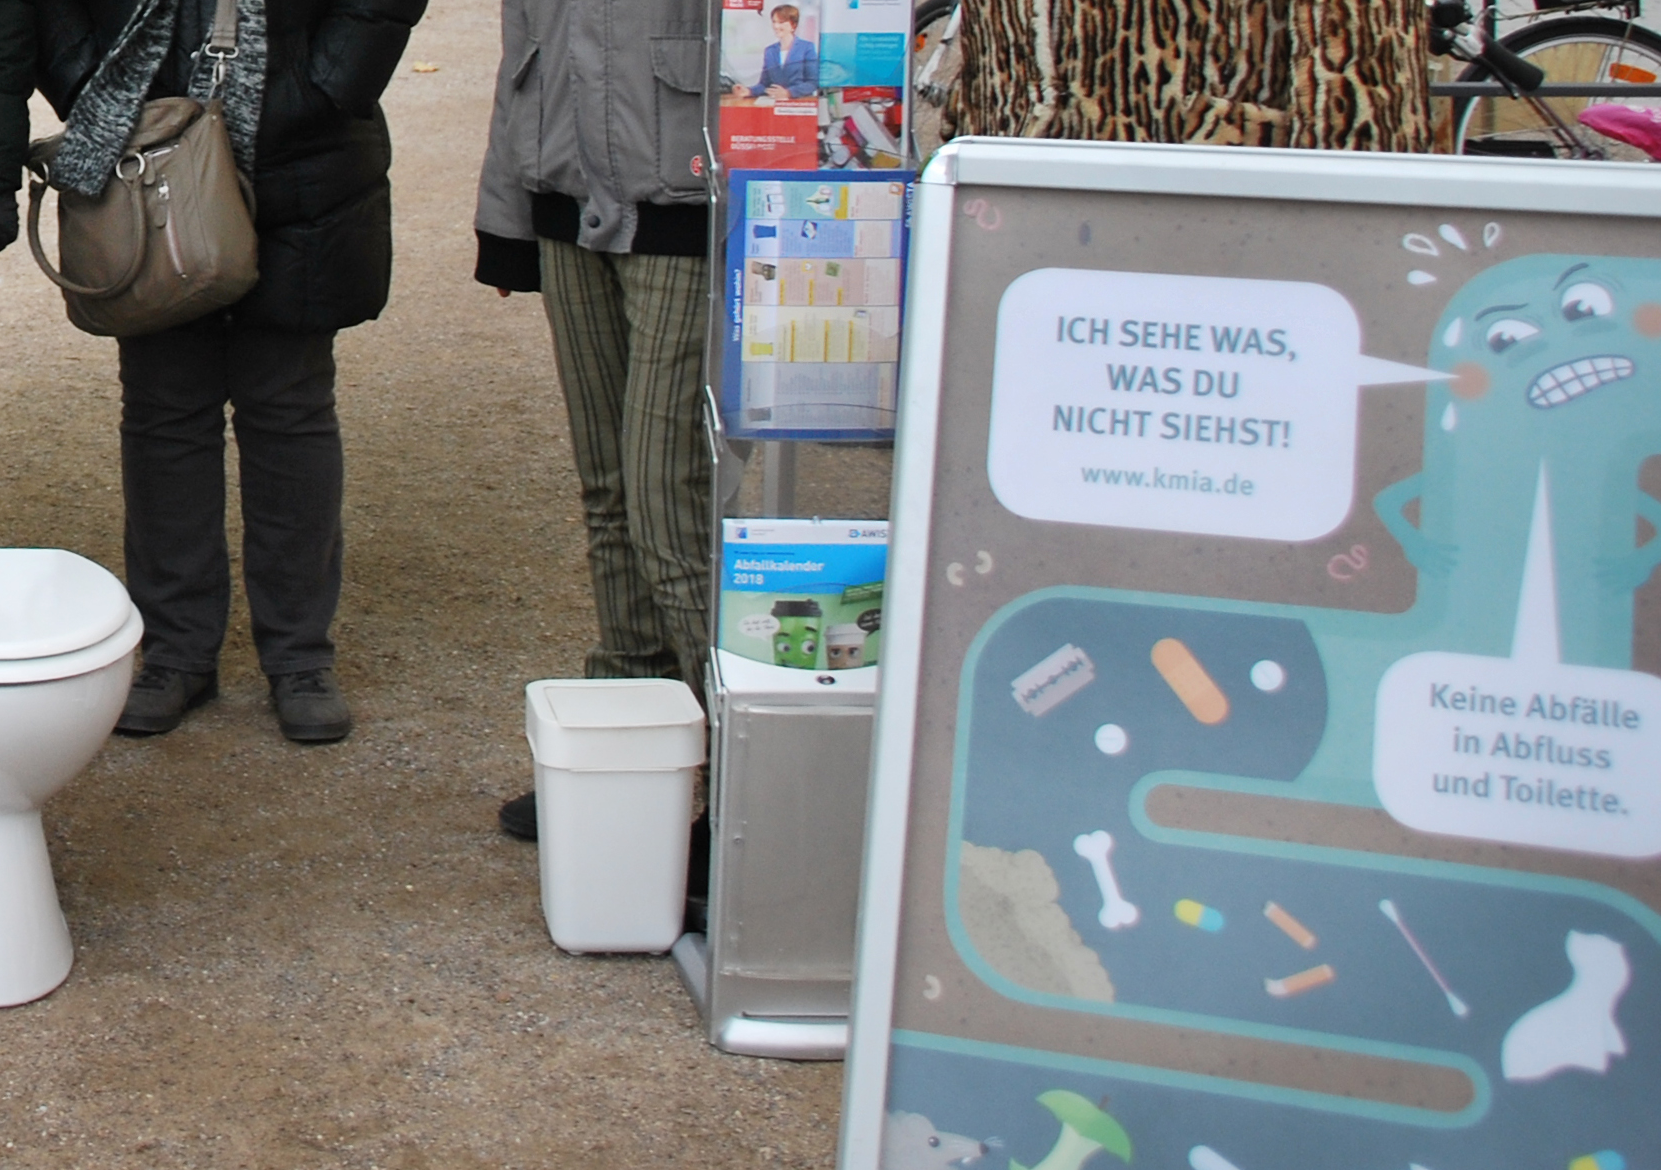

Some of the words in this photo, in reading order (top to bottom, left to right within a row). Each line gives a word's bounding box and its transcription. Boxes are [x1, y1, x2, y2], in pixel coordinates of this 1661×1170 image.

[1056, 316, 1110, 347] ICH
[1119, 318, 1202, 351] SEHE
[1210, 325, 1298, 363] WAS,
[1106, 363, 1183, 395] WAS
[1192, 368, 1240, 399] DU
[1052, 404, 1152, 440] NICHT
[1159, 412, 1292, 450] SIEHST!
[1080, 462, 1255, 497] www.kmia.de
[733, 573, 764, 585] 2018
[734, 558, 825, 572] Abfallkalender
[1429, 682, 1516, 717] Keine
[1524, 692, 1641, 730] Abfälle
[1452, 726, 1481, 755] in
[1489, 732, 1612, 770] Abfluss
[1432, 772, 1491, 799] und
[1499, 775, 1629, 816] Toilette.
